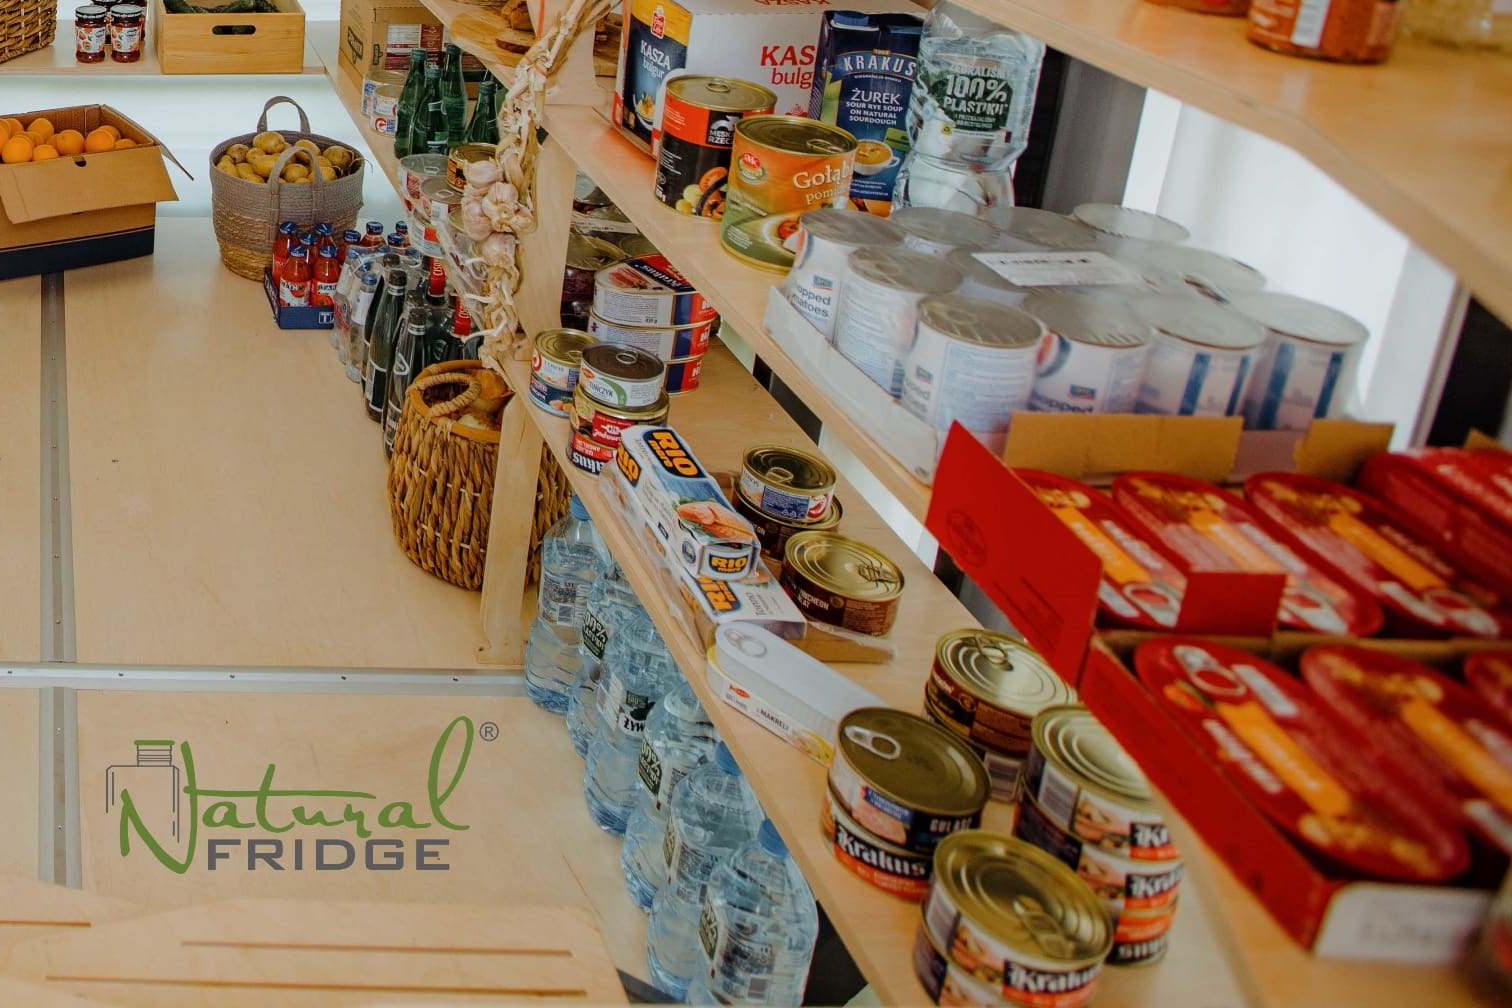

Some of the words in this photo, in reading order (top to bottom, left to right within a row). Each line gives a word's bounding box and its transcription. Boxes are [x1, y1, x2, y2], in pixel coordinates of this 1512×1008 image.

[639, 39, 671, 71] KASZA
[760, 44, 816, 67] KAS
[843, 55, 918, 77] KRAKUS
[642, 57, 666, 80] bulgur
[771, 67, 813, 91] bulg
[850, 88, 901, 106] ŻUREK
[946, 73, 1007, 102] 100%
[845, 101, 866, 109] SOUR
[867, 103, 881, 111] RYE
[880, 104, 904, 113] SOUP
[849, 107, 860, 116] ON
[861, 109, 897, 120] NATURAL
[848, 114, 897, 126] SOURDOUGH
[648, 439, 674, 468] mare
[652, 431, 699, 478] RIO
[711, 556, 747, 569] RIO
[838, 825, 926, 876] Krakus
